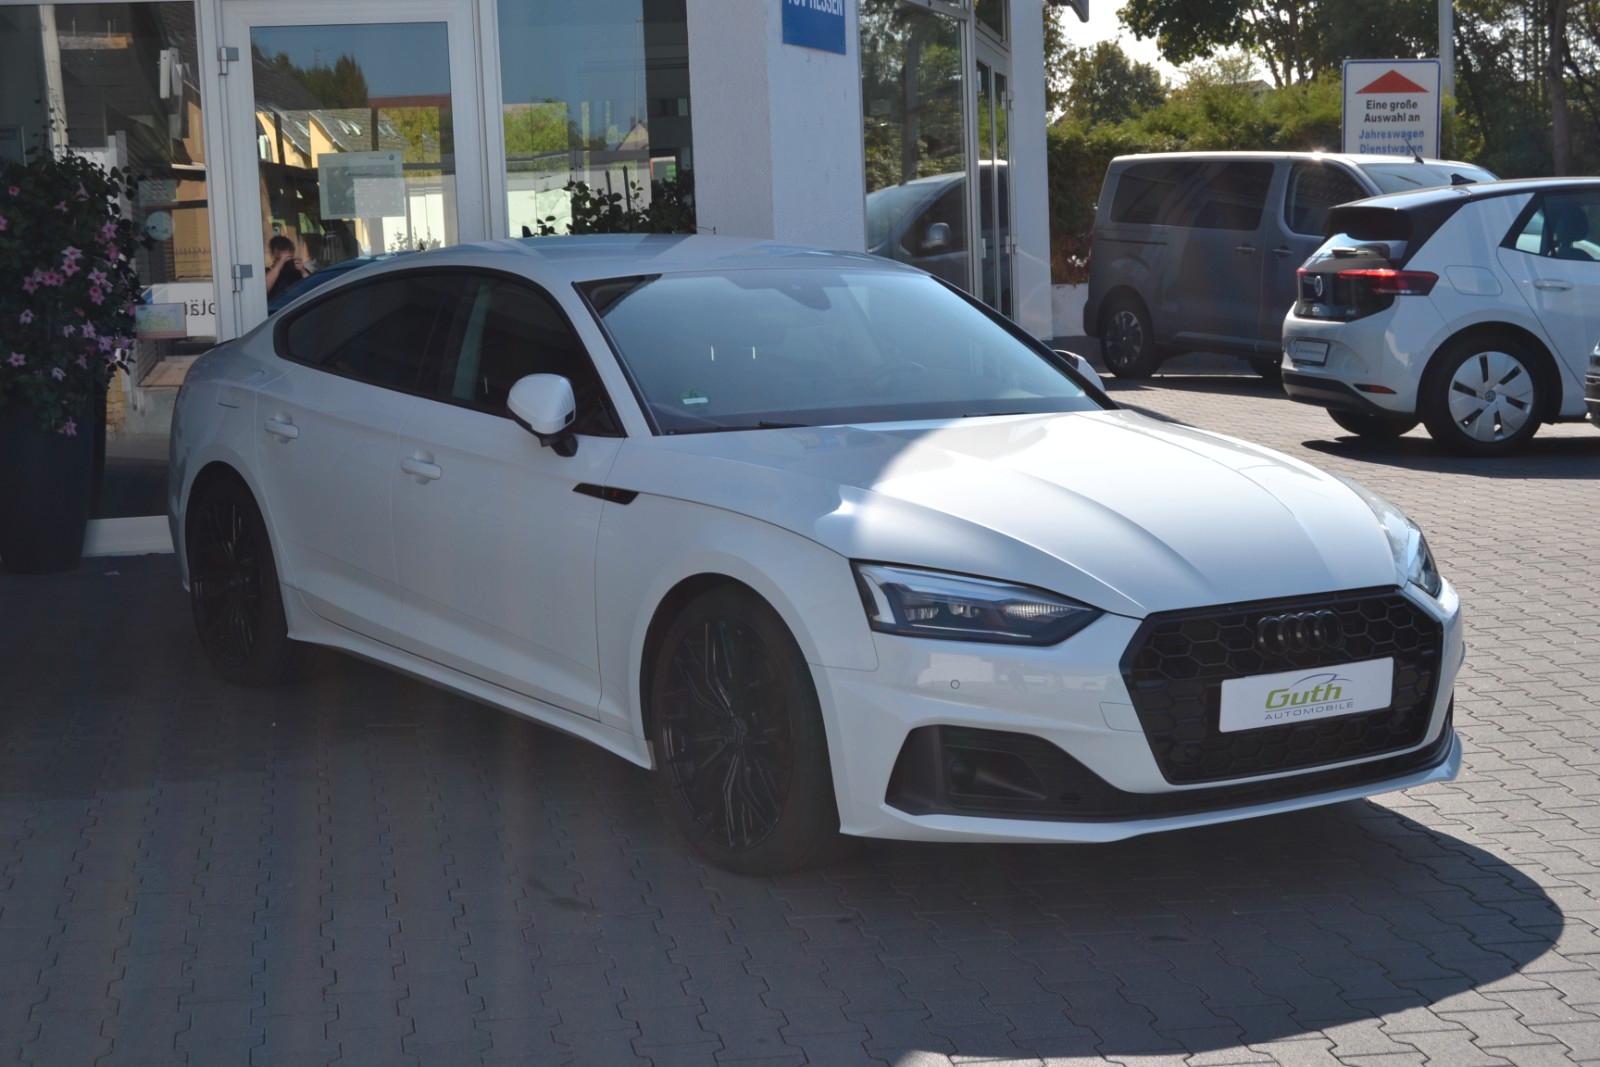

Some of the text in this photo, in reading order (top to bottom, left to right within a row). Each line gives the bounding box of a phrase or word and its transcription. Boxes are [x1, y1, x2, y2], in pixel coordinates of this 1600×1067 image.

[1366, 99, 1418, 112] Eine große
[1364, 113, 1420, 123] Auswahl an
[1359, 129, 1424, 140] Jahreswagen
[1265, 683, 1343, 709] Guth
[1264, 701, 1354, 721] AUTOMOBILE
